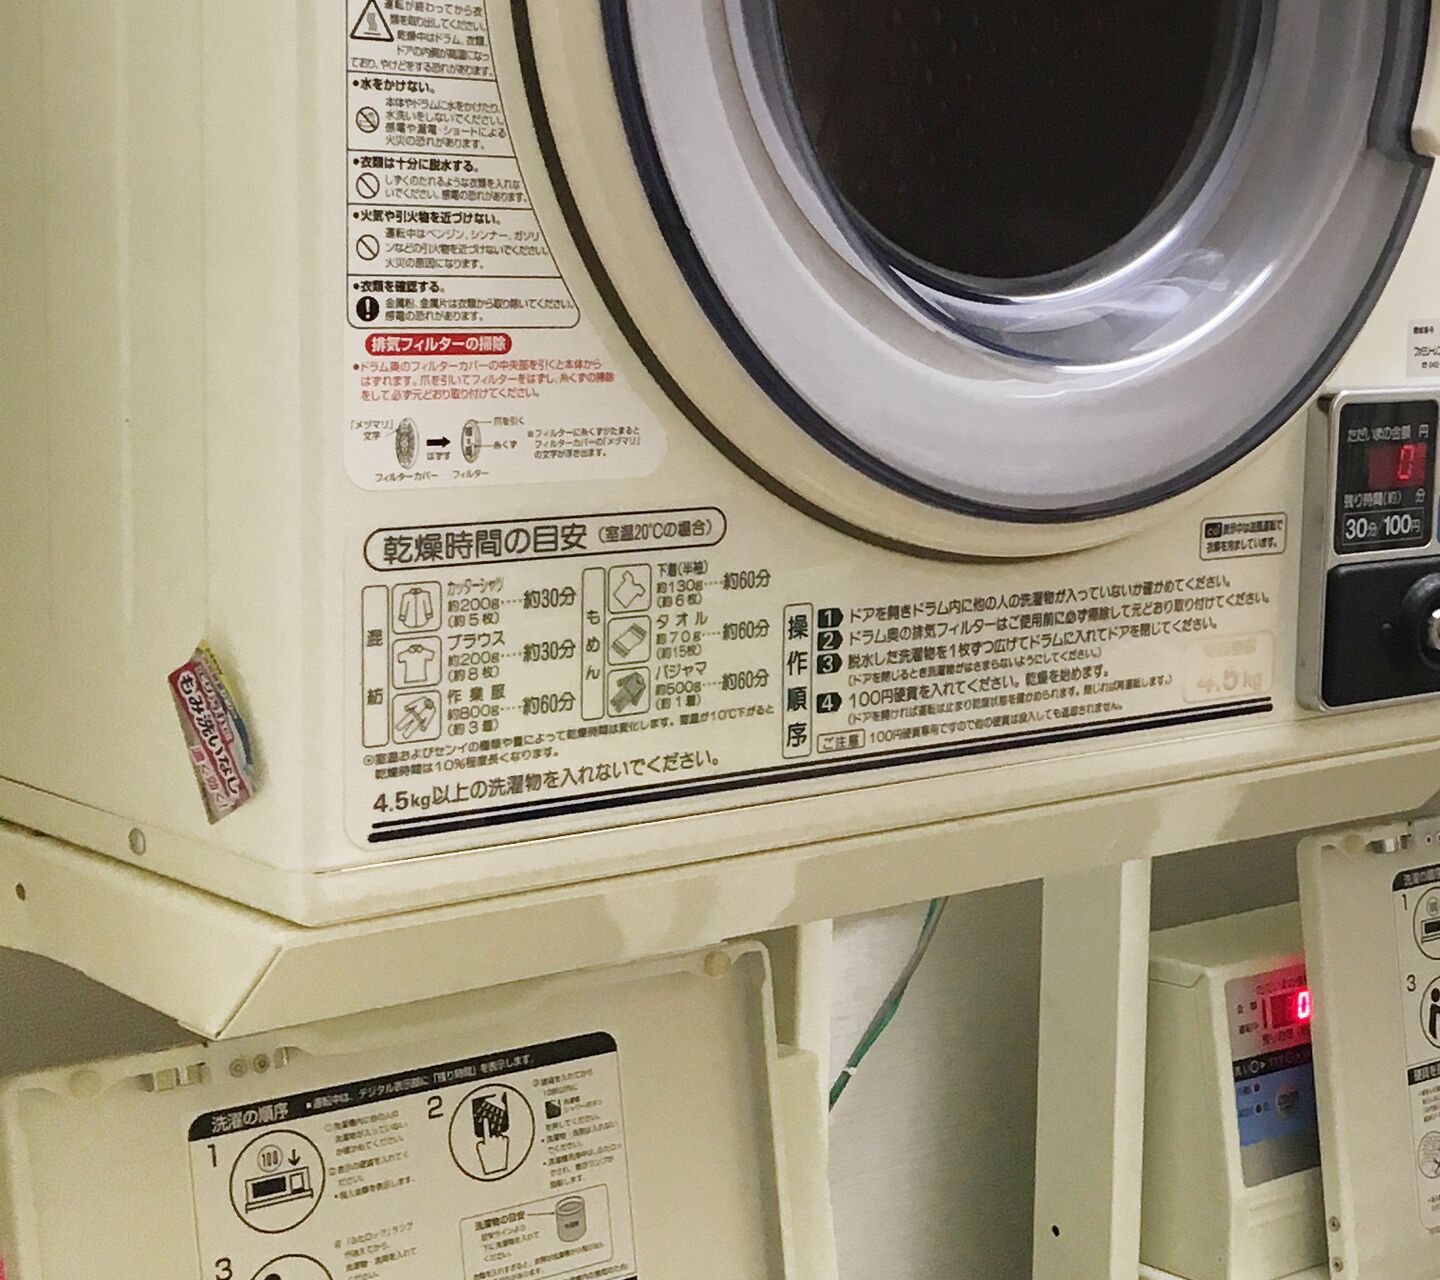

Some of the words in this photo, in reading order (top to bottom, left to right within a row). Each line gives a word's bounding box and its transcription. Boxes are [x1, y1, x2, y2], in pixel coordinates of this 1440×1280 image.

[360, 79, 436, 94] 水をかけない。
[360, 157, 479, 172] 衣類は十分に脱水する。
[370, 335, 507, 353] 排気フィルターの掃除
[1418, 423, 1429, 439] 円
[1396, 444, 1416, 481] 0
[1415, 487, 1426, 503] 分
[383, 523, 588, 566] 乾燥時間の目安
[722, 568, 772, 590] 約60分
[522, 586, 577, 609] 約30分
[447, 630, 506, 651] ブラウス
[722, 619, 771, 641] 約60分
[522, 639, 576, 663] 約30分
[655, 661, 708, 680] パジャマ
[721, 669, 770, 691] 約60分
[522, 691, 576, 716] 約60分
[372, 751, 719, 814] 4.5kg以上の洗濯物を入れないでください。
[1406, 974, 1417, 992] 3
[1297, 991, 1311, 1020] 0
[427, 1094, 444, 1120] 2
